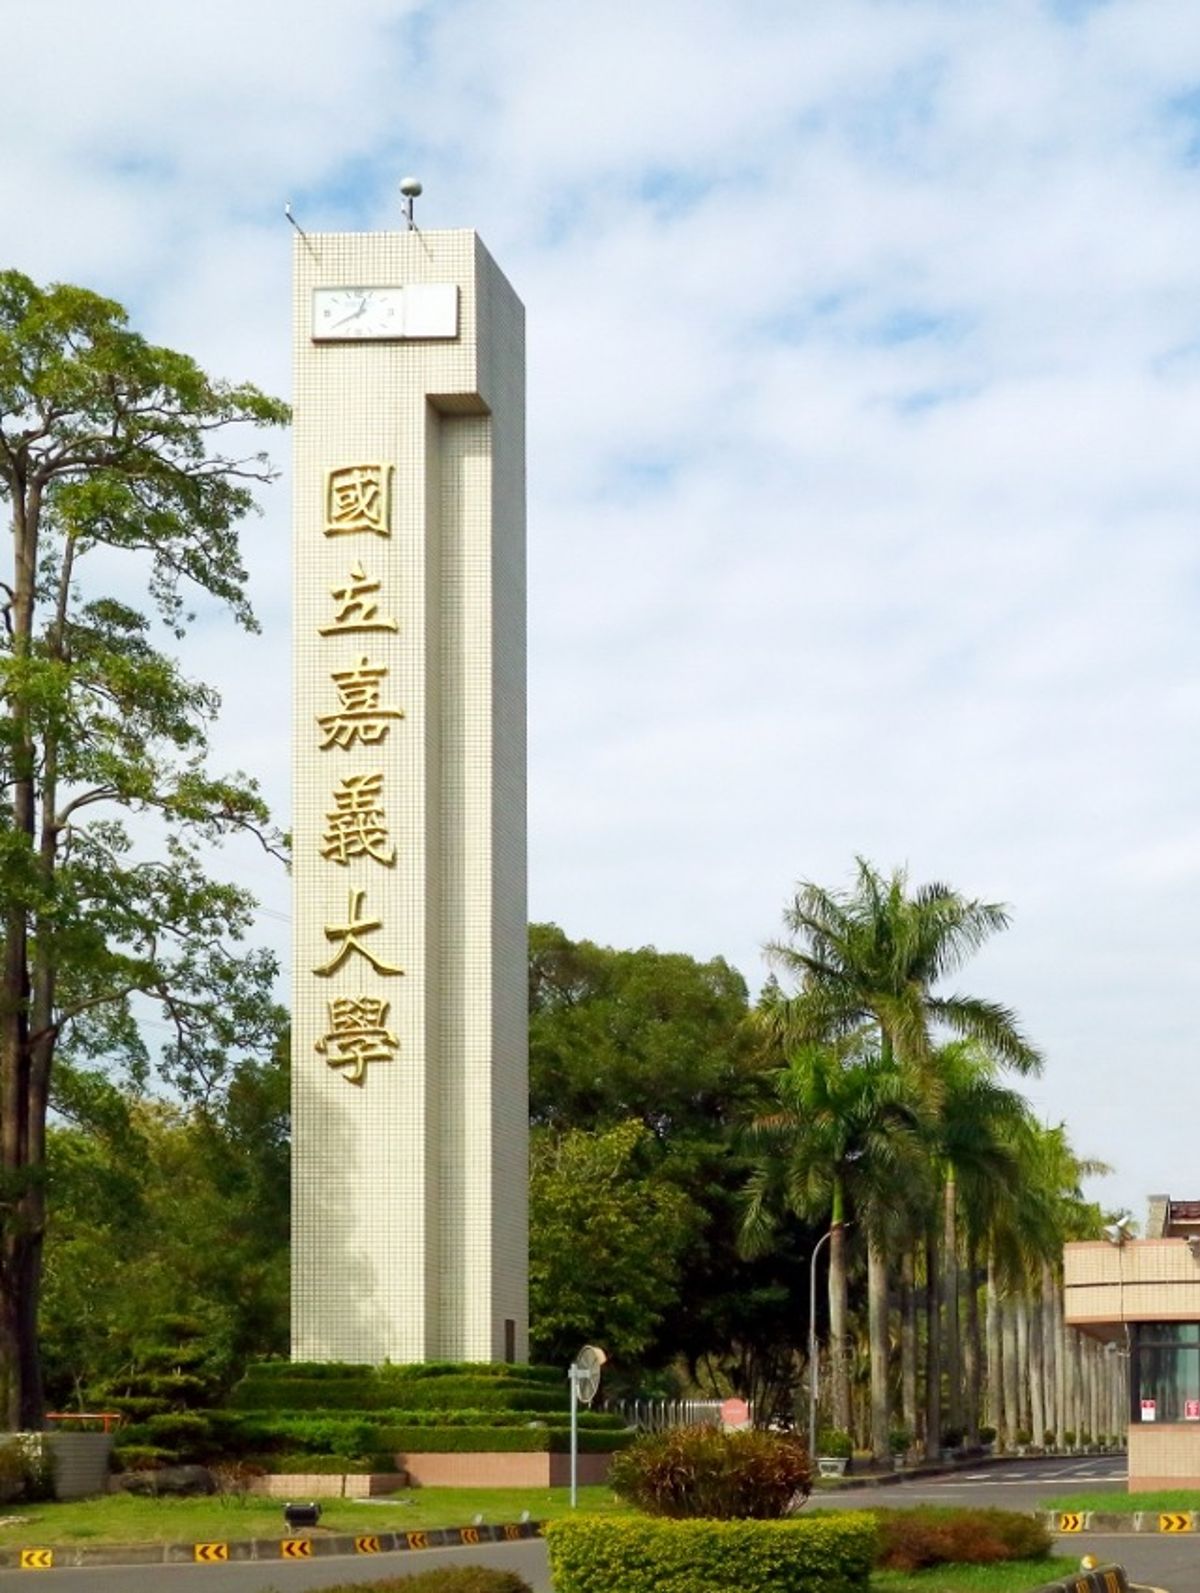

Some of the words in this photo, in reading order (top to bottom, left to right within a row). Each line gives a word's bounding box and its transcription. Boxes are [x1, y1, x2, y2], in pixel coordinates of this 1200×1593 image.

[312, 463, 404, 1086] 國立嘉義大學
